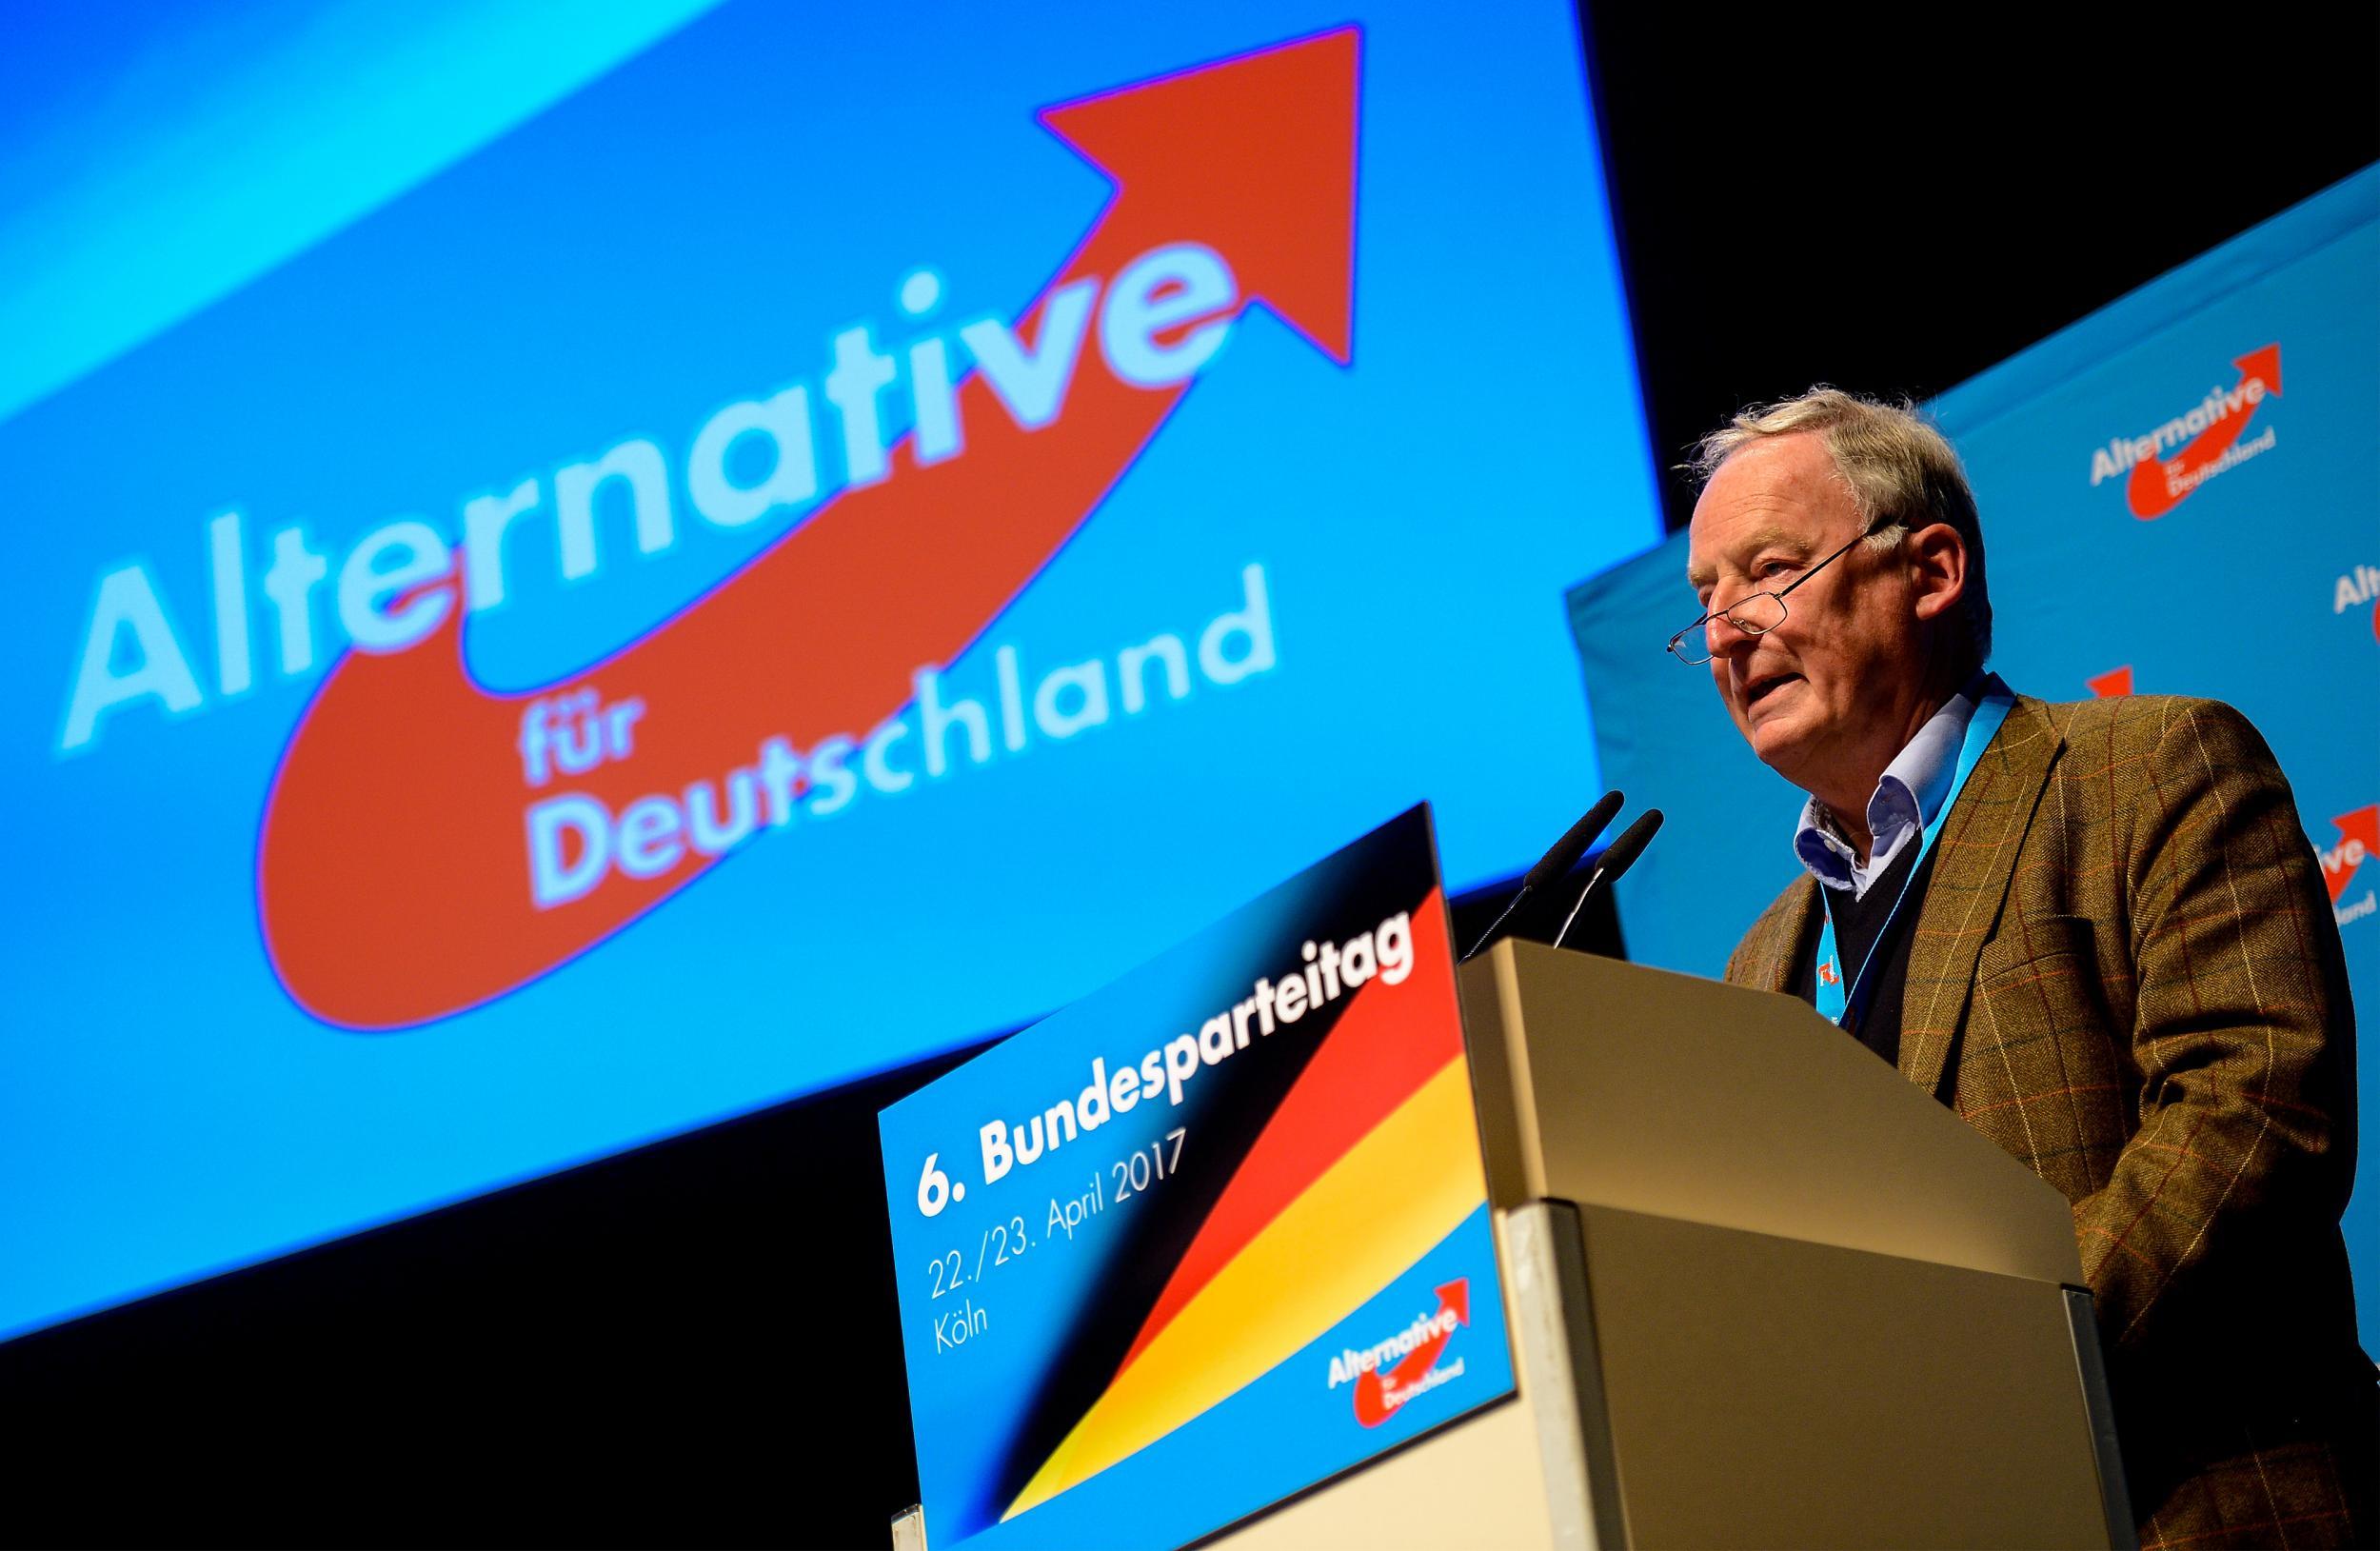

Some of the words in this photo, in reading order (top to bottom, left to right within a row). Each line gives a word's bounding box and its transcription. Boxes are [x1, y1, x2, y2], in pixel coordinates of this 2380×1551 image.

[57, 243, 1240, 754] Alternative
[2091, 378, 2265, 486] Alternative
[520, 689, 645, 785] für
[526, 564, 1278, 909] Deutschland
[917, 1152, 965, 1217] 6.
[979, 911, 1414, 1185] Bundesparteitag
[928, 1216, 1036, 1299] 22./23.
[1047, 1172, 1104, 1240] April
[1112, 1127, 1187, 1203] 2017
[934, 1299, 987, 1354] Köln
[1328, 1309, 1458, 1389] Alternative
